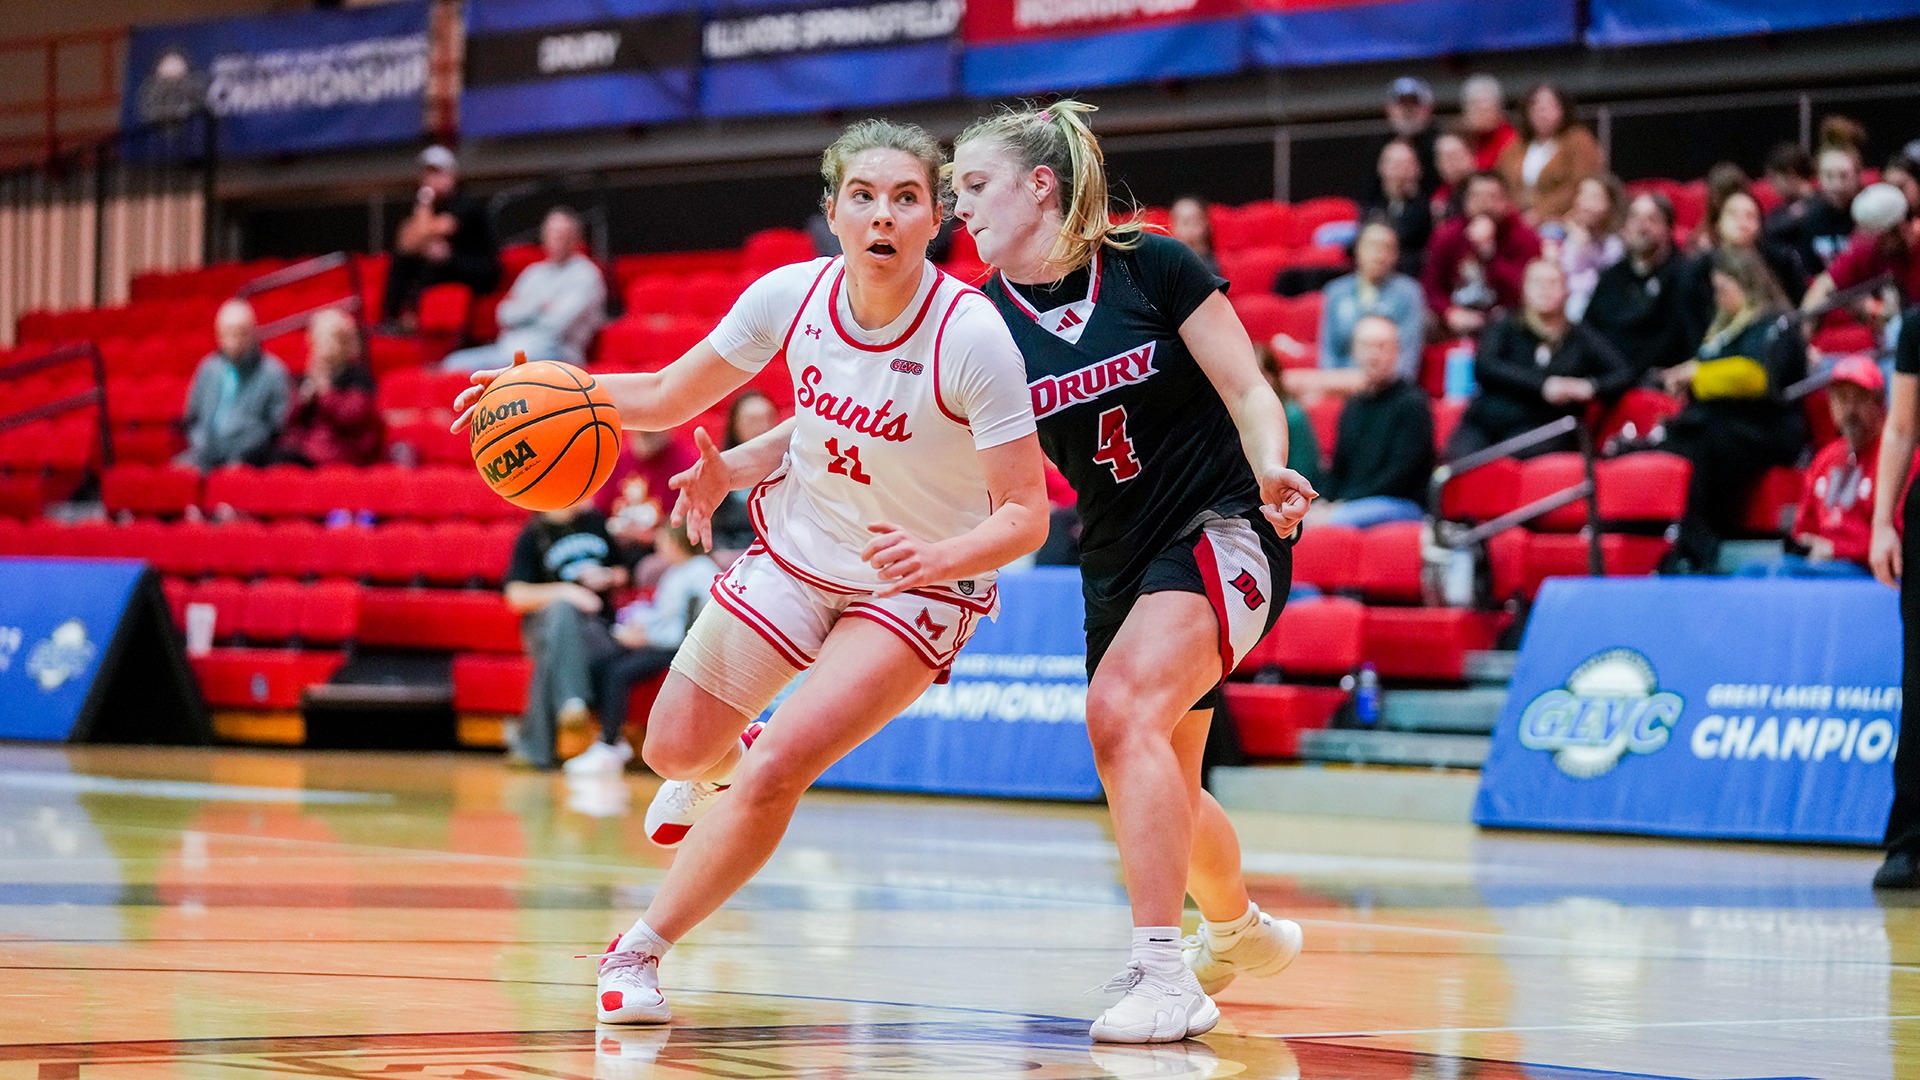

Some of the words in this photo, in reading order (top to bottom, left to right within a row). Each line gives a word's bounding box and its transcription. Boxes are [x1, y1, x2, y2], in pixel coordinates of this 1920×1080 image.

[890, 358, 924, 375] GLVC
[1029, 345, 1153, 418] DRURY
[797, 365, 913, 442] Saints
[482, 439, 538, 485] NCAA
[824, 437, 871, 485] 11
[1093, 405, 1142, 484] 4
[1228, 567, 1266, 611] DU
[1706, 683, 1771, 709] GREAT
[1770, 684, 1834, 710] LAKES
[1519, 688, 1684, 755] GLVC
